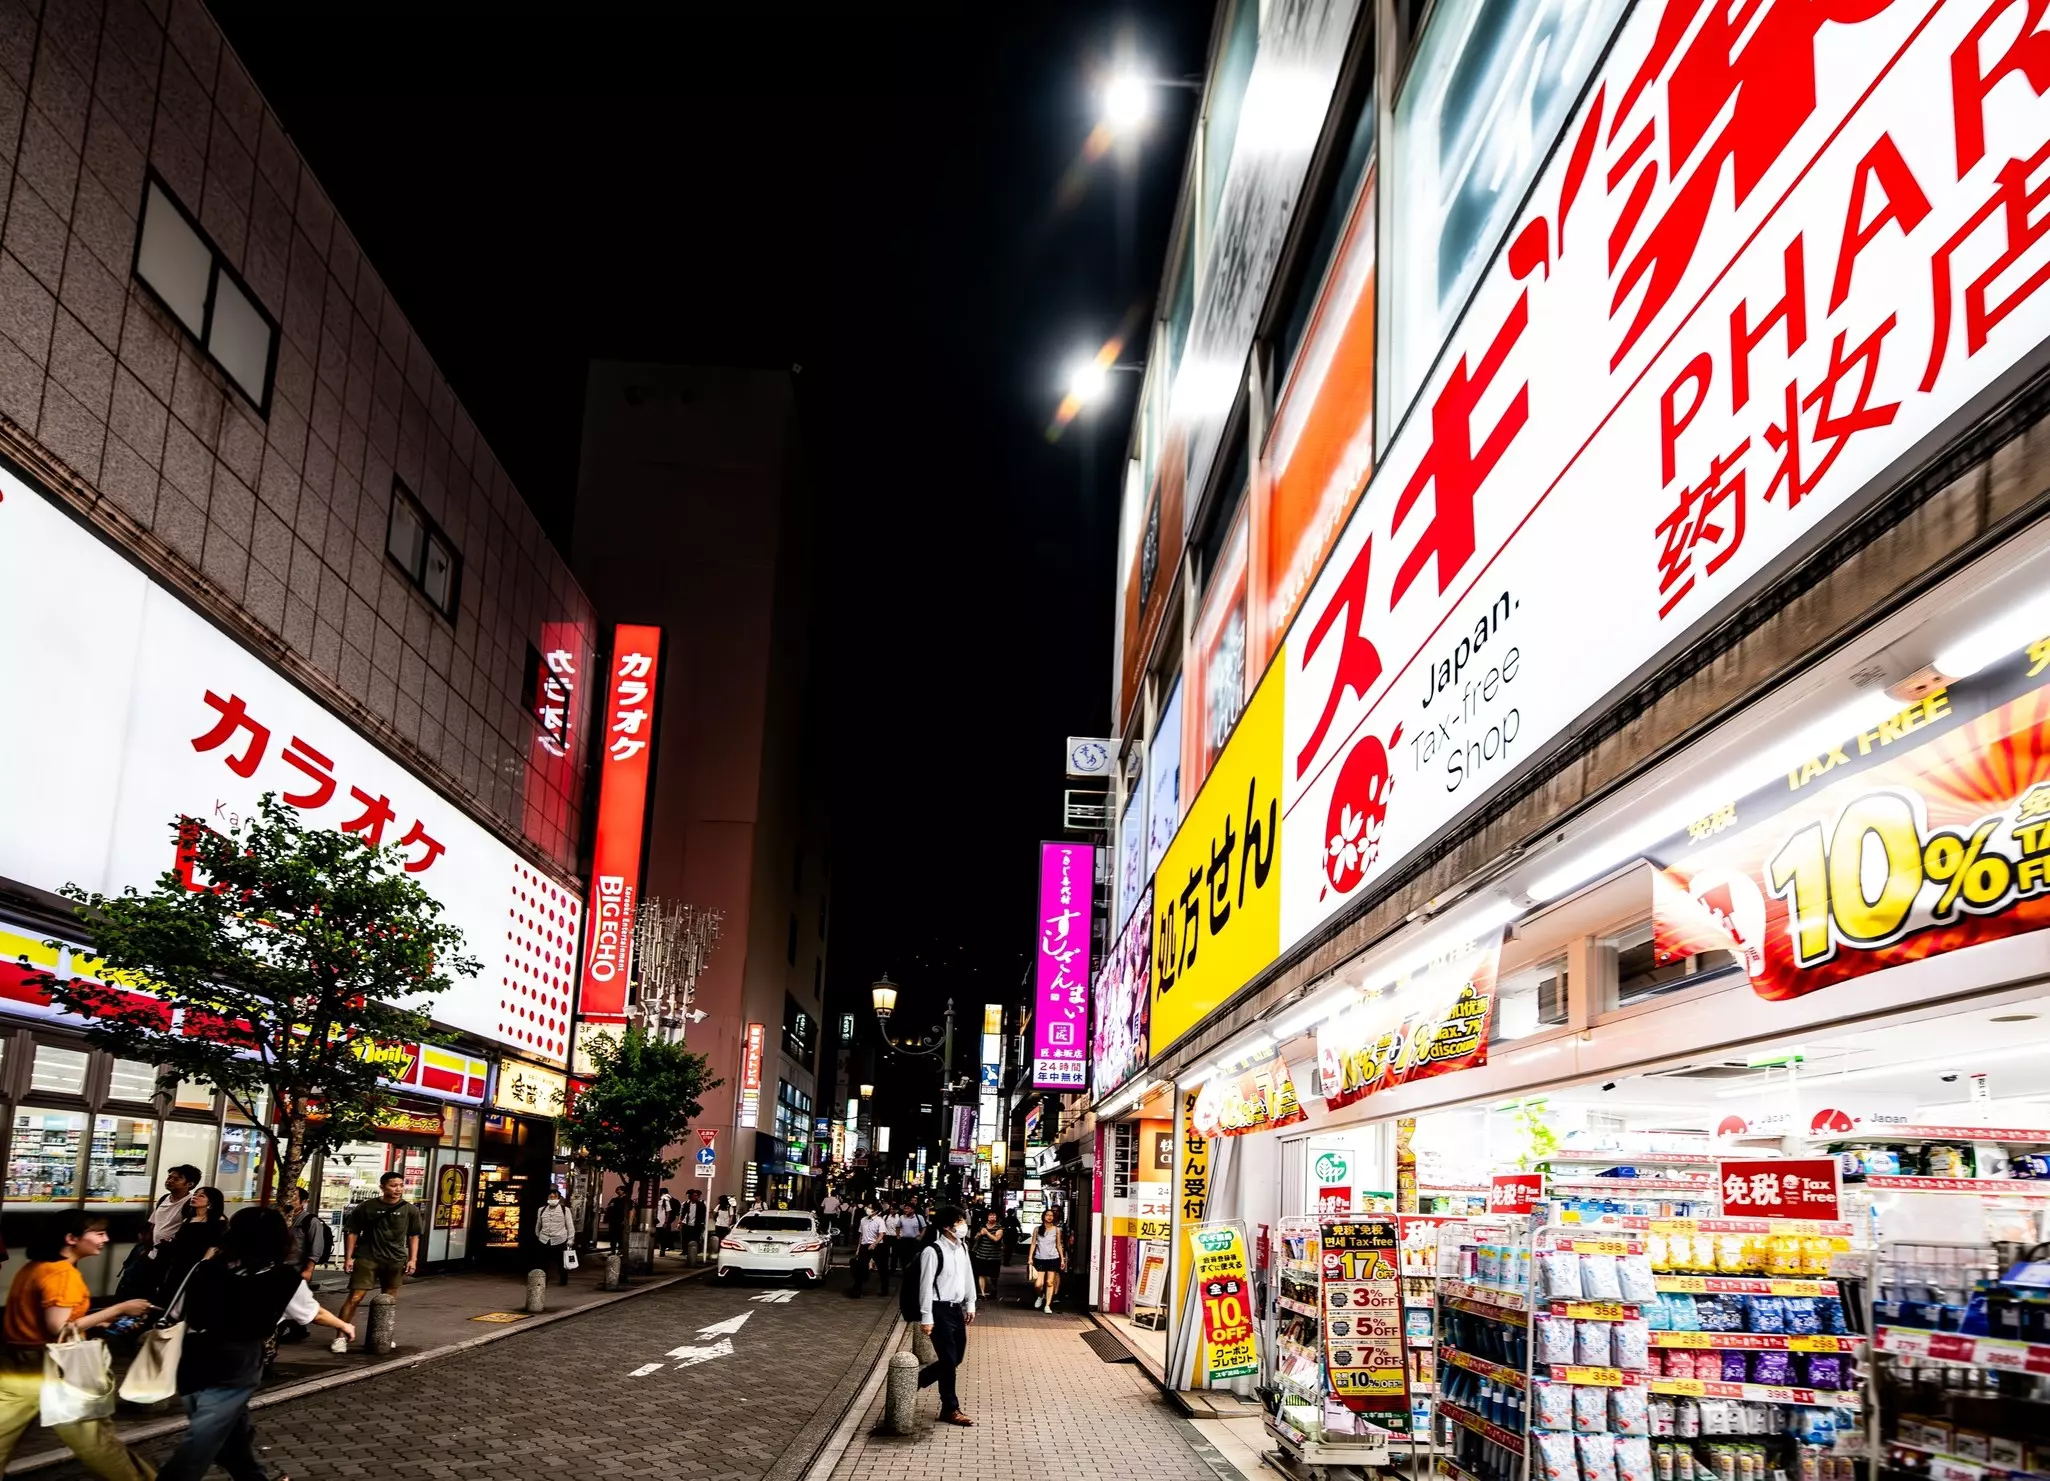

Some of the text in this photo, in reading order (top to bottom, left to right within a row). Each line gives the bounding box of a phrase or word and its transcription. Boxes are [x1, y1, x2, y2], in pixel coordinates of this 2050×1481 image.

[1422, 590, 1520, 709] Japan.
[609, 652, 653, 761] カラオケ
[1410, 646, 1520, 772] Tax-free
[1787, 743, 1852, 791] TAX
[1858, 685, 1953, 757] FREE
[1446, 708, 1520, 793] Shop
[191, 688, 447, 873] カラオケ
[1770, 789, 2010, 968] 10%
[1156, 776, 1277, 999] 処方せん
[591, 875, 625, 982] BIG ECHO
[617, 886, 633, 972] Karaoke Entertainment
[1042, 909, 1086, 1020] すしざんまい
[1040, 1062, 1081, 1072] 24時間
[1038, 1072, 1083, 1082] 年中無休
[1723, 1173, 1782, 1206] 免税
[1802, 1178, 1831, 1190] Tax
[1802, 1190, 1837, 1203] Free
[1324, 1237, 1395, 1248] 면세 Tax-free
[1600, 1242, 1623, 1251] 398
[1200, 1261, 1243, 1273] すぐに使える
[1340, 1251, 1388, 1280] 17%
[1376, 1270, 1395, 1280] OFF
[1209, 1282, 1238, 1296] 全品
[1353, 1288, 1383, 1307] 3%
[1371, 1298, 1395, 1307] OFF
[1594, 1306, 1619, 1316] 358
[1212, 1327, 1247, 1342] OFF
[1356, 1317, 1386, 1336] 5%
[1373, 1327, 1398, 1336] OFF
[1216, 1345, 1249, 1358] クーポン
[1357, 1347, 1389, 1365] 7%
[1212, 1355, 1254, 1368] プレゼント
[1374, 1356, 1399, 1366] OFF
[1592, 1371, 1617, 1381] 358
